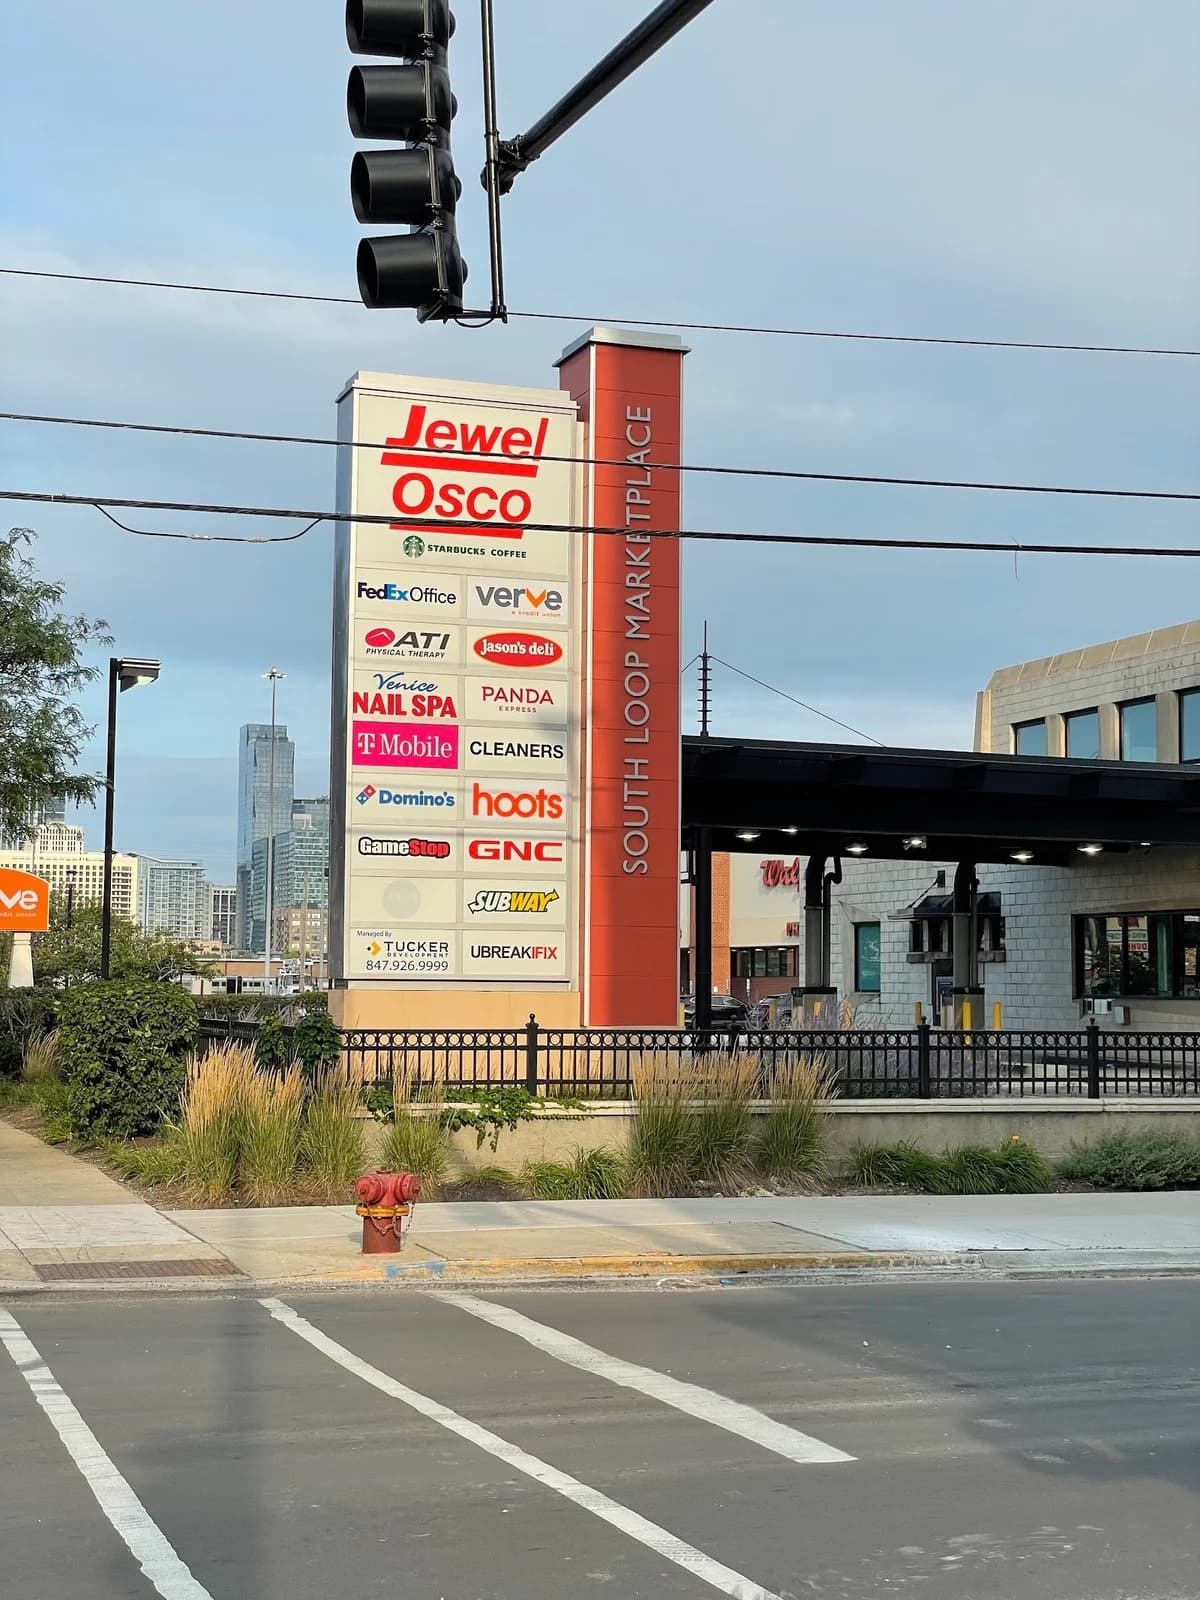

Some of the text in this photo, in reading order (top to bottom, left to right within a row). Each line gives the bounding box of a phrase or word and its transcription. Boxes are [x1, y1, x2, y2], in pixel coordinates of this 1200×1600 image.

[385, 405, 549, 462] Jewel
[392, 472, 531, 523] Osco
[427, 544, 527, 558] STARBUCKS COFFEE
[357, 582, 457, 604] FedEx Office
[475, 585, 563, 611] verve
[394, 631, 450, 650] ATI
[480, 638, 555, 656] Jason's deli
[623, 405, 652, 876] SOUTH LOOP MARKETPLACE
[366, 648, 446, 660] PHYSICAL THERAPY
[373, 672, 438, 692] Venice
[353, 692, 458, 718] NAIL SPA
[482, 687, 554, 705] PANDA
[499, 705, 537, 713] EXPRESS
[470, 741, 564, 759] CLEANERS
[378, 790, 455, 807] Domino's
[472, 782, 563, 819] hoots
[358, 837, 451, 858] GameStop
[468, 841, 563, 862] GNC
[468, 889, 559, 914] SUBWAY
[357, 930, 384, 938] Managed
[384, 941, 449, 952] TUCKER
[471, 945, 557, 960] UBREAKIFIX
[366, 960, 449, 971] 847.926.9999
